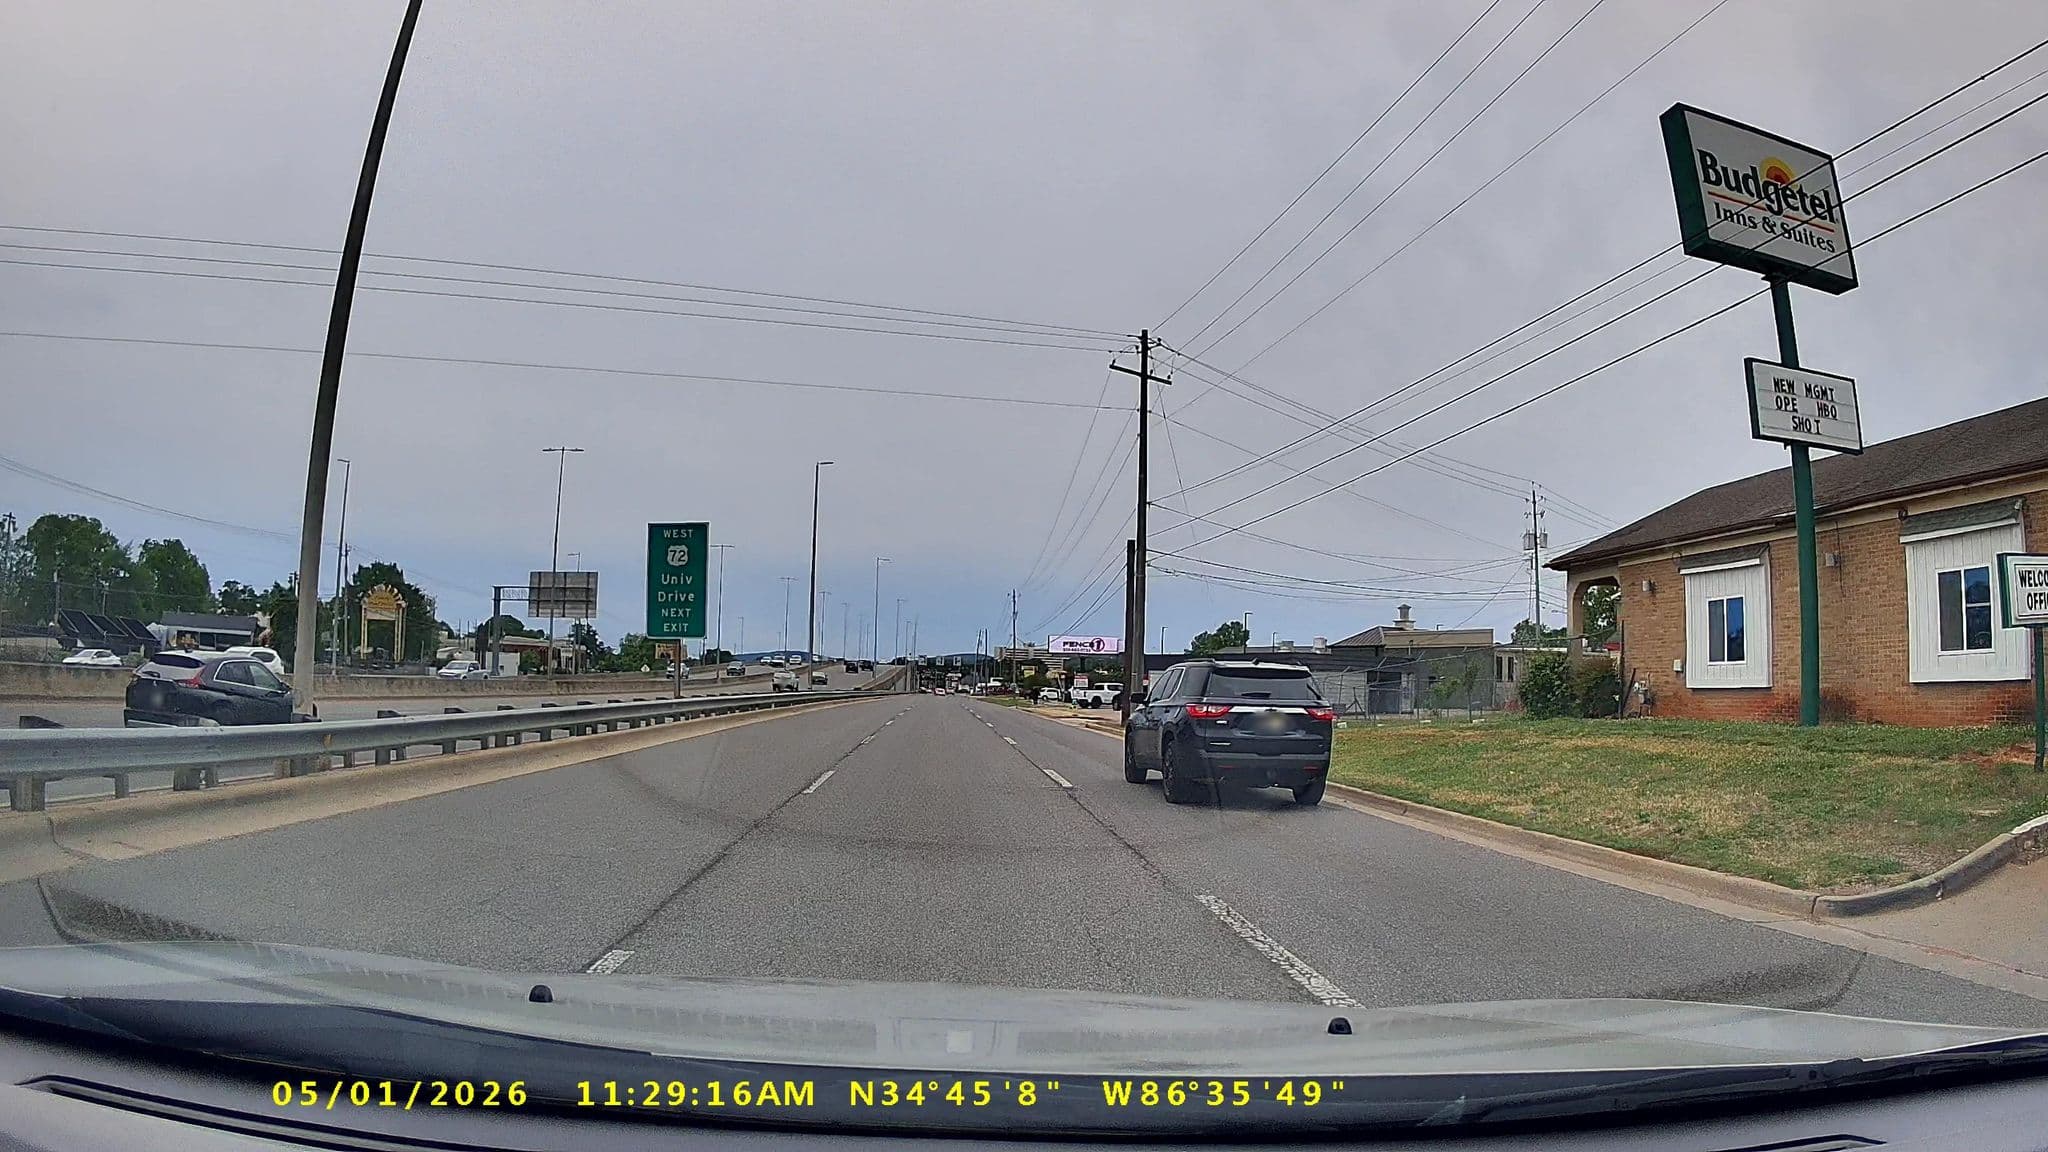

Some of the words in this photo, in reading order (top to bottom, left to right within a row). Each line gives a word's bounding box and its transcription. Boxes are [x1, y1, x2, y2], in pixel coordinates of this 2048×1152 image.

[1697, 149, 1837, 224] Budgetel
[1714, 202, 1758, 230] Inns
[1762, 215, 1777, 235] &
[1780, 221, 1836, 253] Suites
[1773, 377, 1796, 395] NEW
[1804, 383, 1834, 402] MGMT
[1775, 395, 1799, 413] OPE
[1817, 401, 1838, 420] HBO
[663, 529, 694, 538] WEST
[669, 549, 686, 562] 72
[661, 573, 693, 585] Univ
[658, 591, 695, 602] Drive
[2027, 592, 2048, 611] OFFI
[661, 608, 692, 617] NEXT
[663, 623, 689, 632] EXIT
